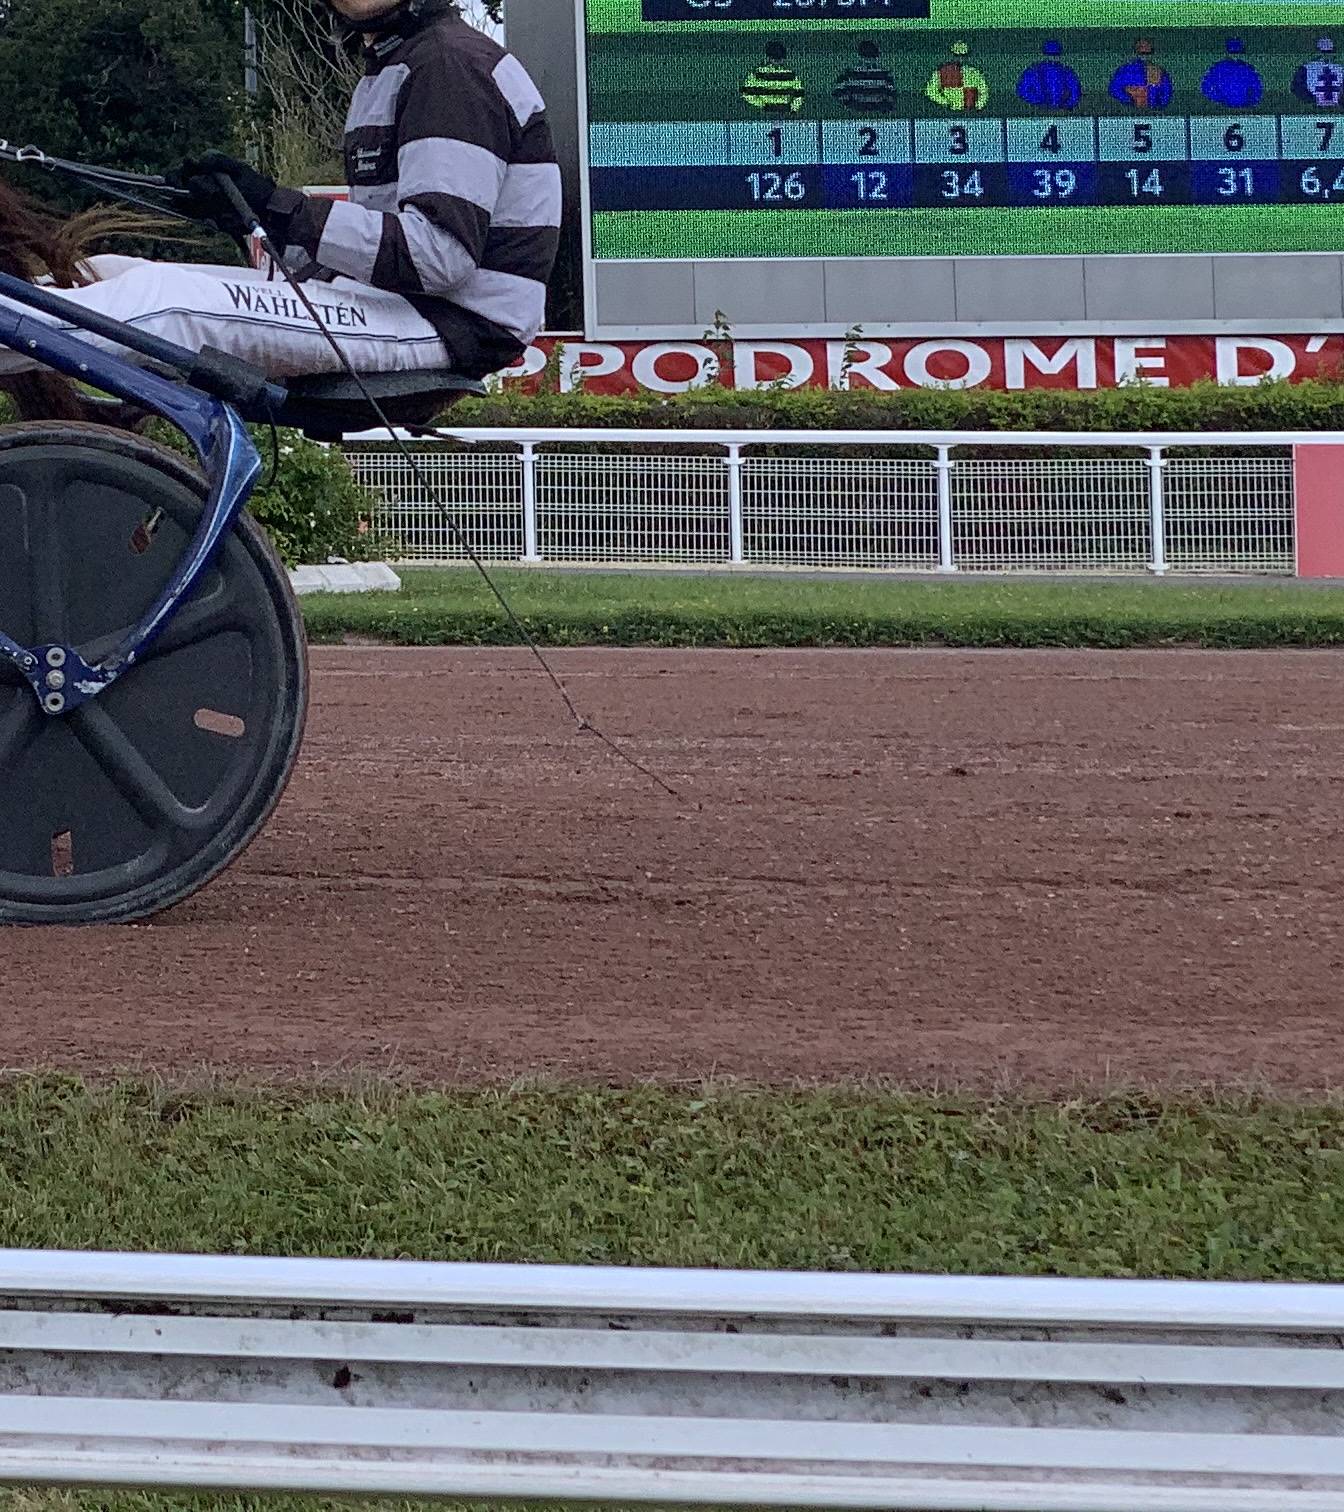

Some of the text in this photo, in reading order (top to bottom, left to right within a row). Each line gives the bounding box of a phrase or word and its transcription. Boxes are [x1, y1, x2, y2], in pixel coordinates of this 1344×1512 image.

[767, 121, 1335, 157] 1 2 3 4 5 6 7
[745, 170, 805, 201] 126
[850, 170, 888, 201] 12
[941, 169, 985, 200] 34
[1032, 168, 1077, 199] 39
[1125, 168, 1164, 198] 14
[1216, 167, 1254, 197] 31
